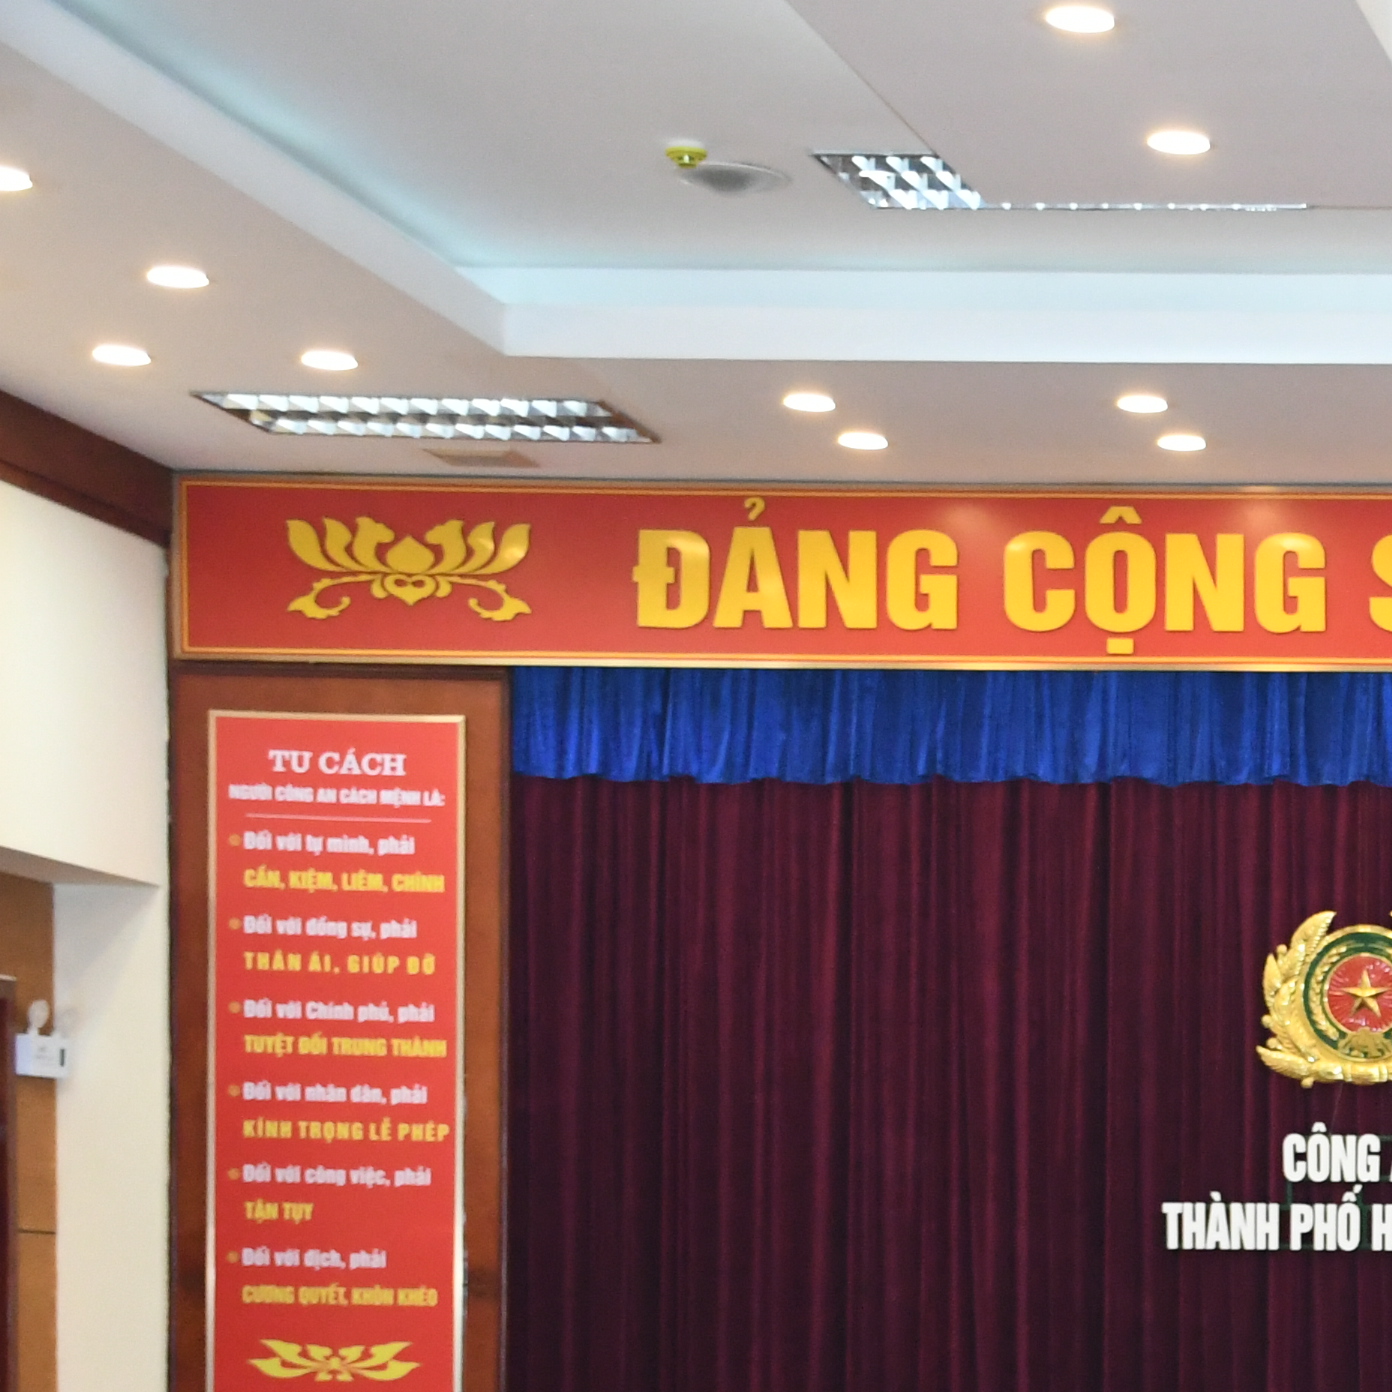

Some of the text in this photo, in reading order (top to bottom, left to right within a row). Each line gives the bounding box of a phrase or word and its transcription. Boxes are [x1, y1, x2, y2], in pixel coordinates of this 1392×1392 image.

[636, 499, 956, 629] ĐẢNG
[1006, 508, 1324, 653] CỘNG
[319, 747, 406, 776] CÁCH
[1283, 1122, 1380, 1182] CÔNG
[1162, 1192, 1279, 1250] THÀNH
[1290, 1186, 1362, 1251] PHỐ
